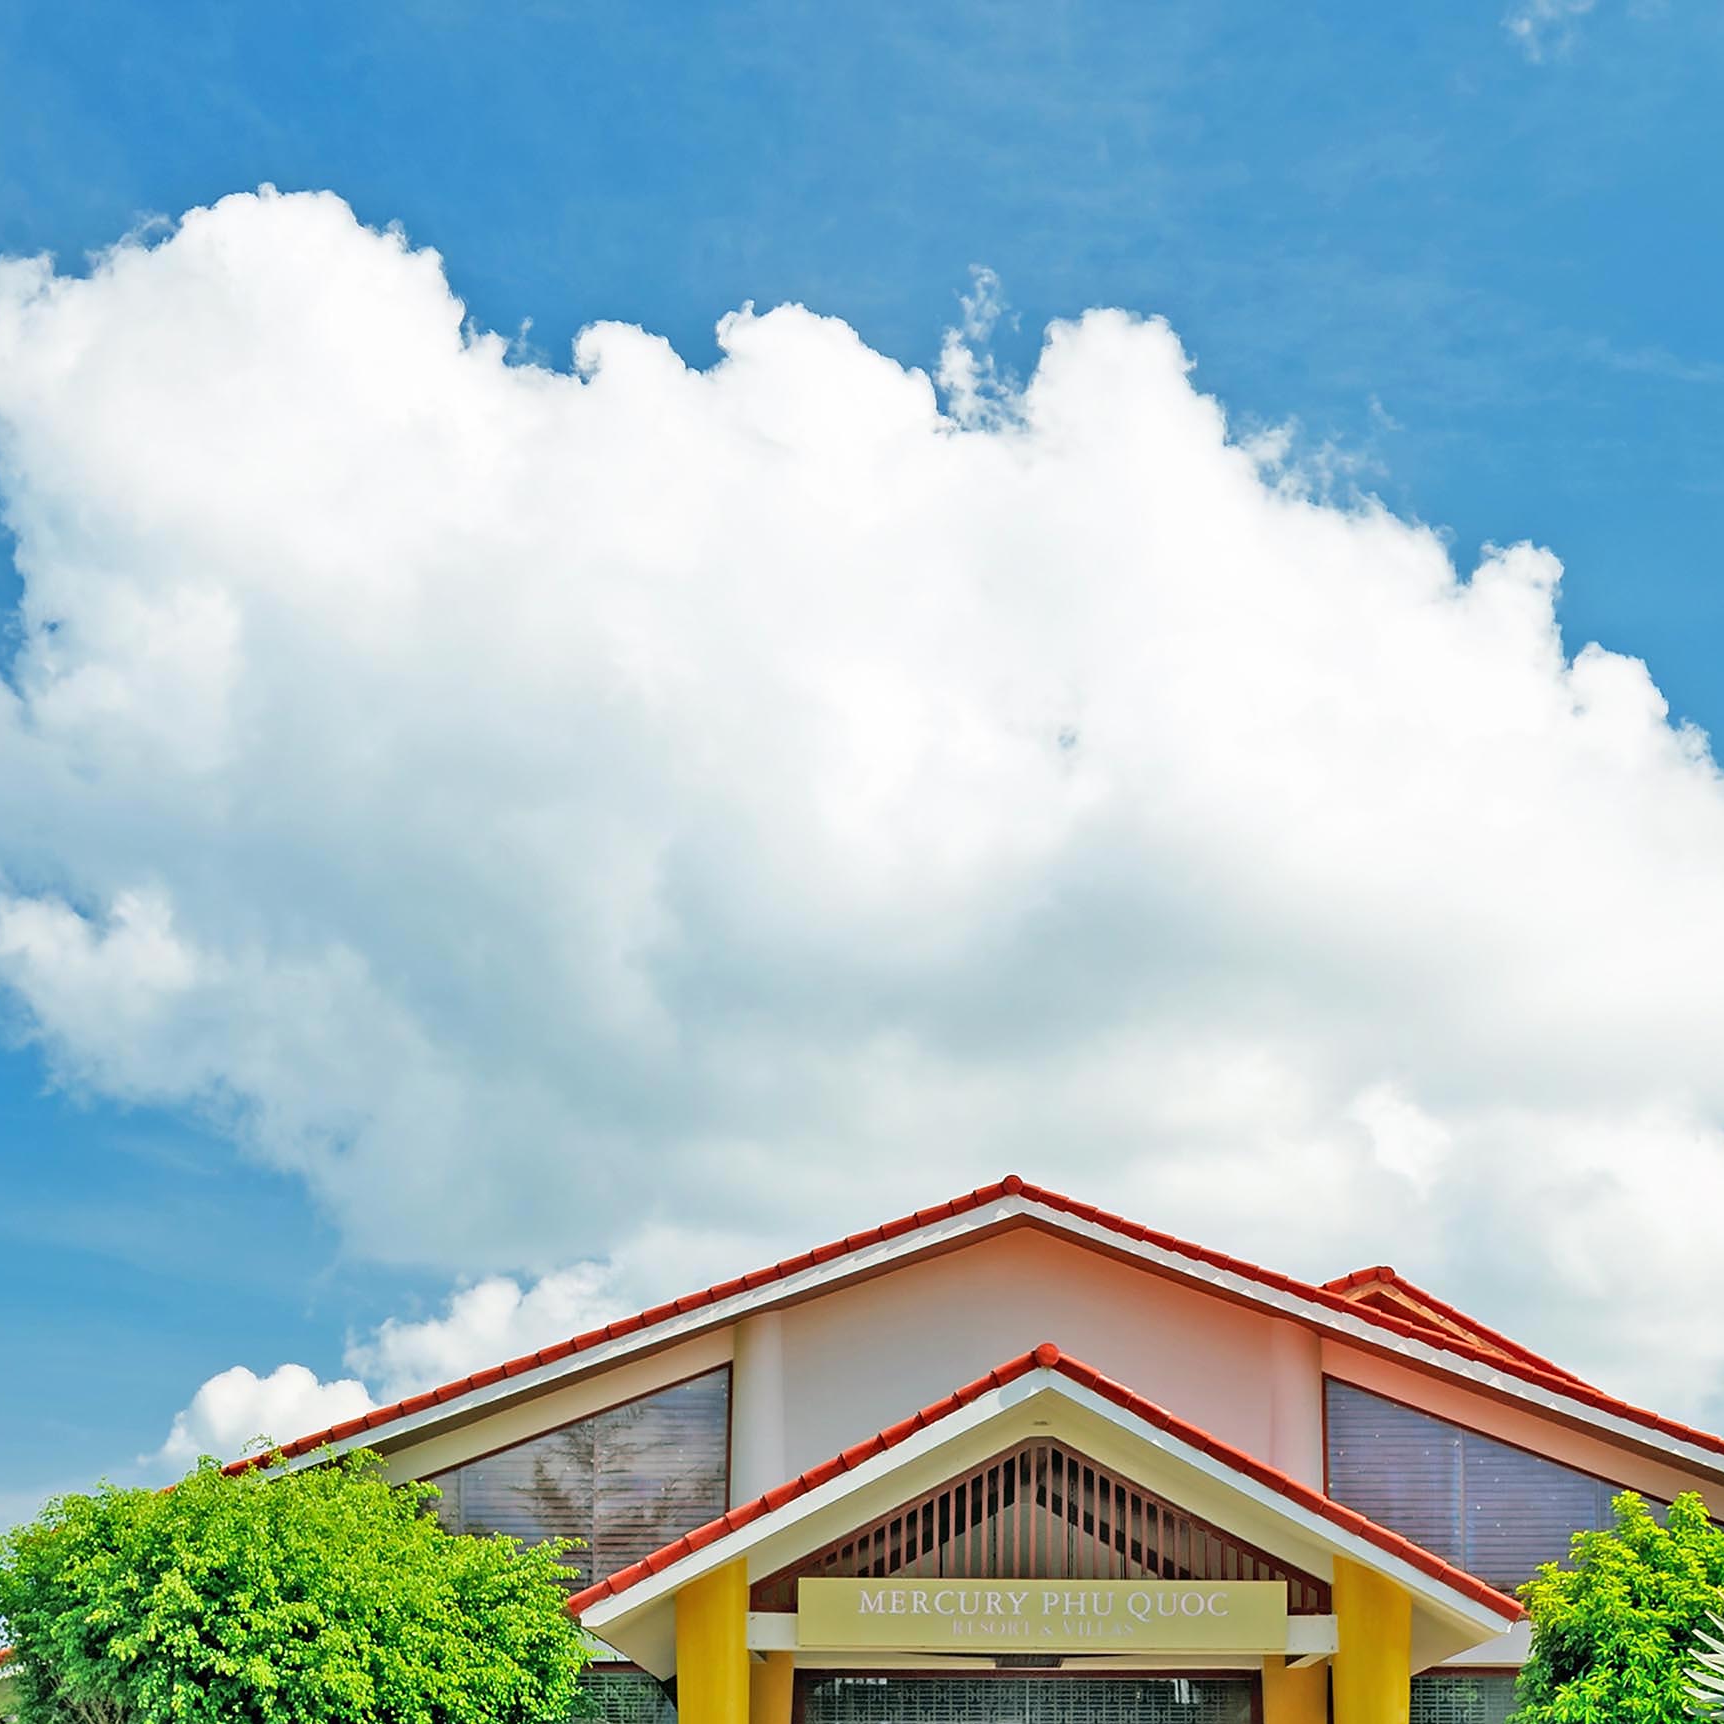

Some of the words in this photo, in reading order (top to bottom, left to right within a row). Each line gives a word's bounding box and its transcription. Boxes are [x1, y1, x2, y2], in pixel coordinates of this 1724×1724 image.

[857, 1589, 1030, 1616] MERCURY
[1041, 1590, 1115, 1617] PHU
[1126, 1591, 1230, 1623] QUOC
[951, 1619, 1031, 1637] RESORT
[1039, 1624, 1055, 1637] &
[1062, 1620, 1135, 1637] VILLAS
